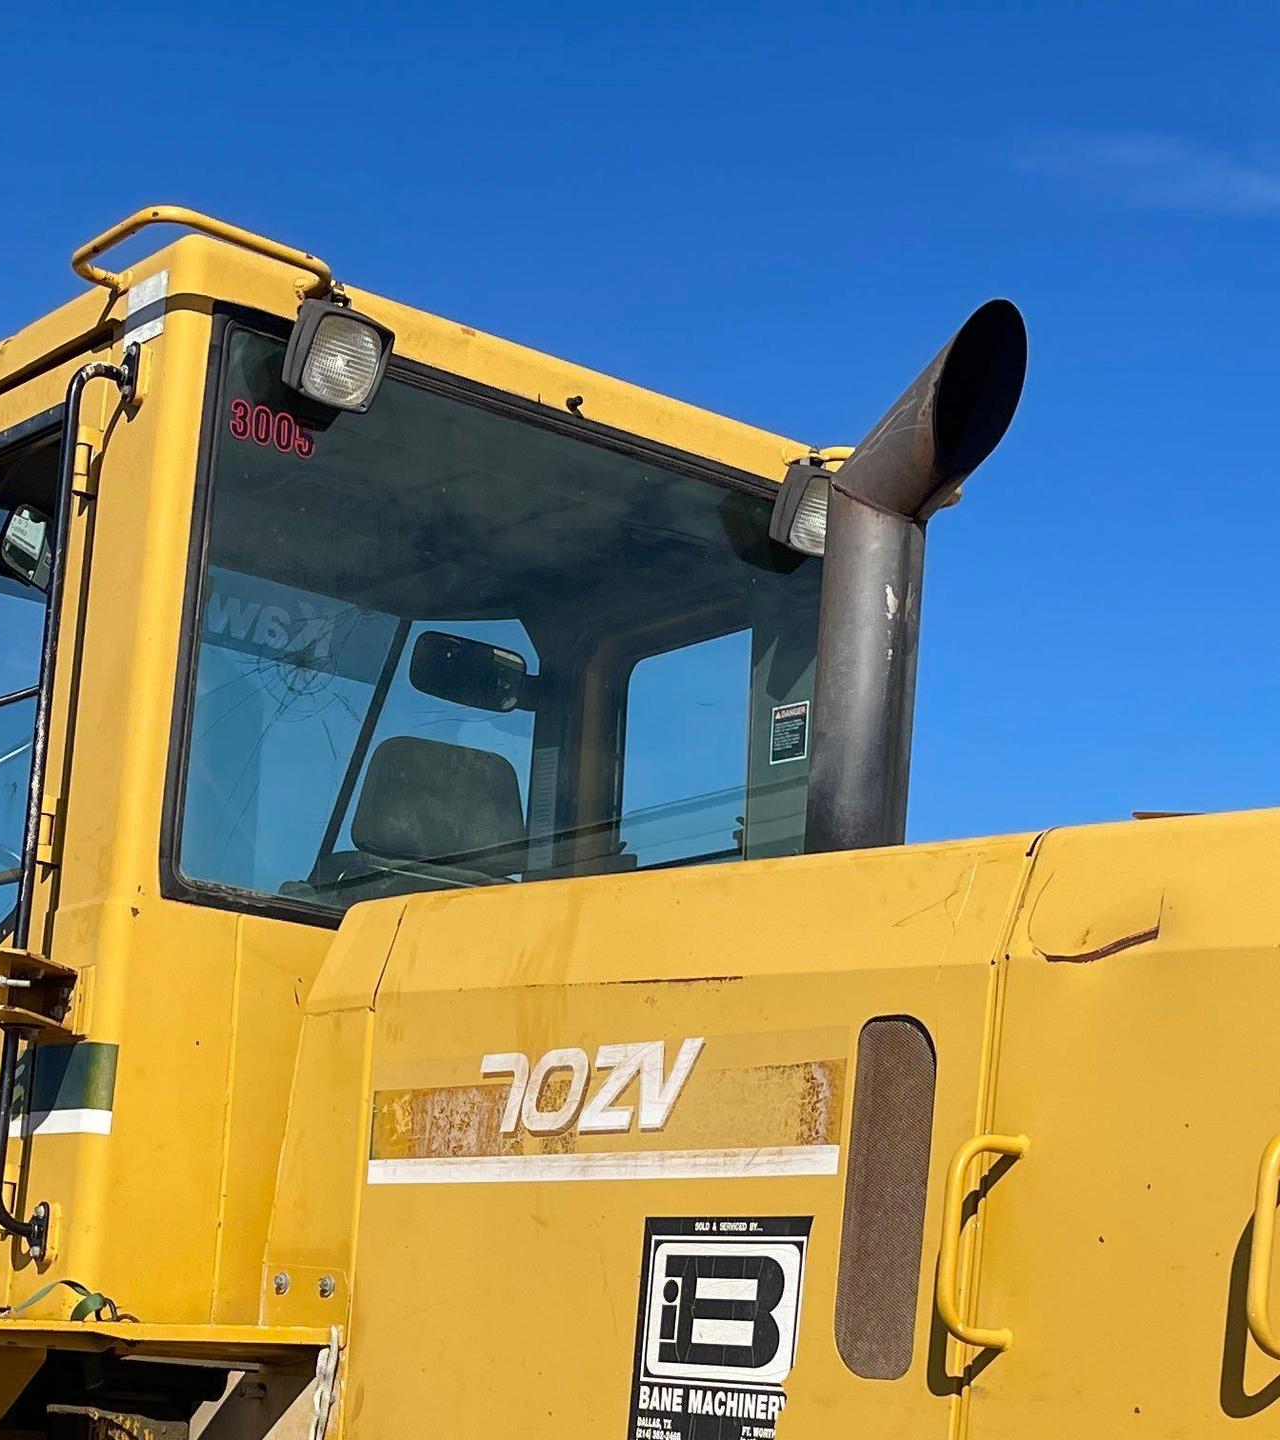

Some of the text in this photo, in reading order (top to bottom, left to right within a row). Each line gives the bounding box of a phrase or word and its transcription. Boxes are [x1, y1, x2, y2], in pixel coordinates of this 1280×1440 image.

[229, 398, 315, 459] 3005
[480, 1037, 705, 1135] 70ZV
[694, 1221, 711, 1232] SOLD
[638, 1385, 683, 1412] BANE
[663, 1418, 672, 1429] TX
